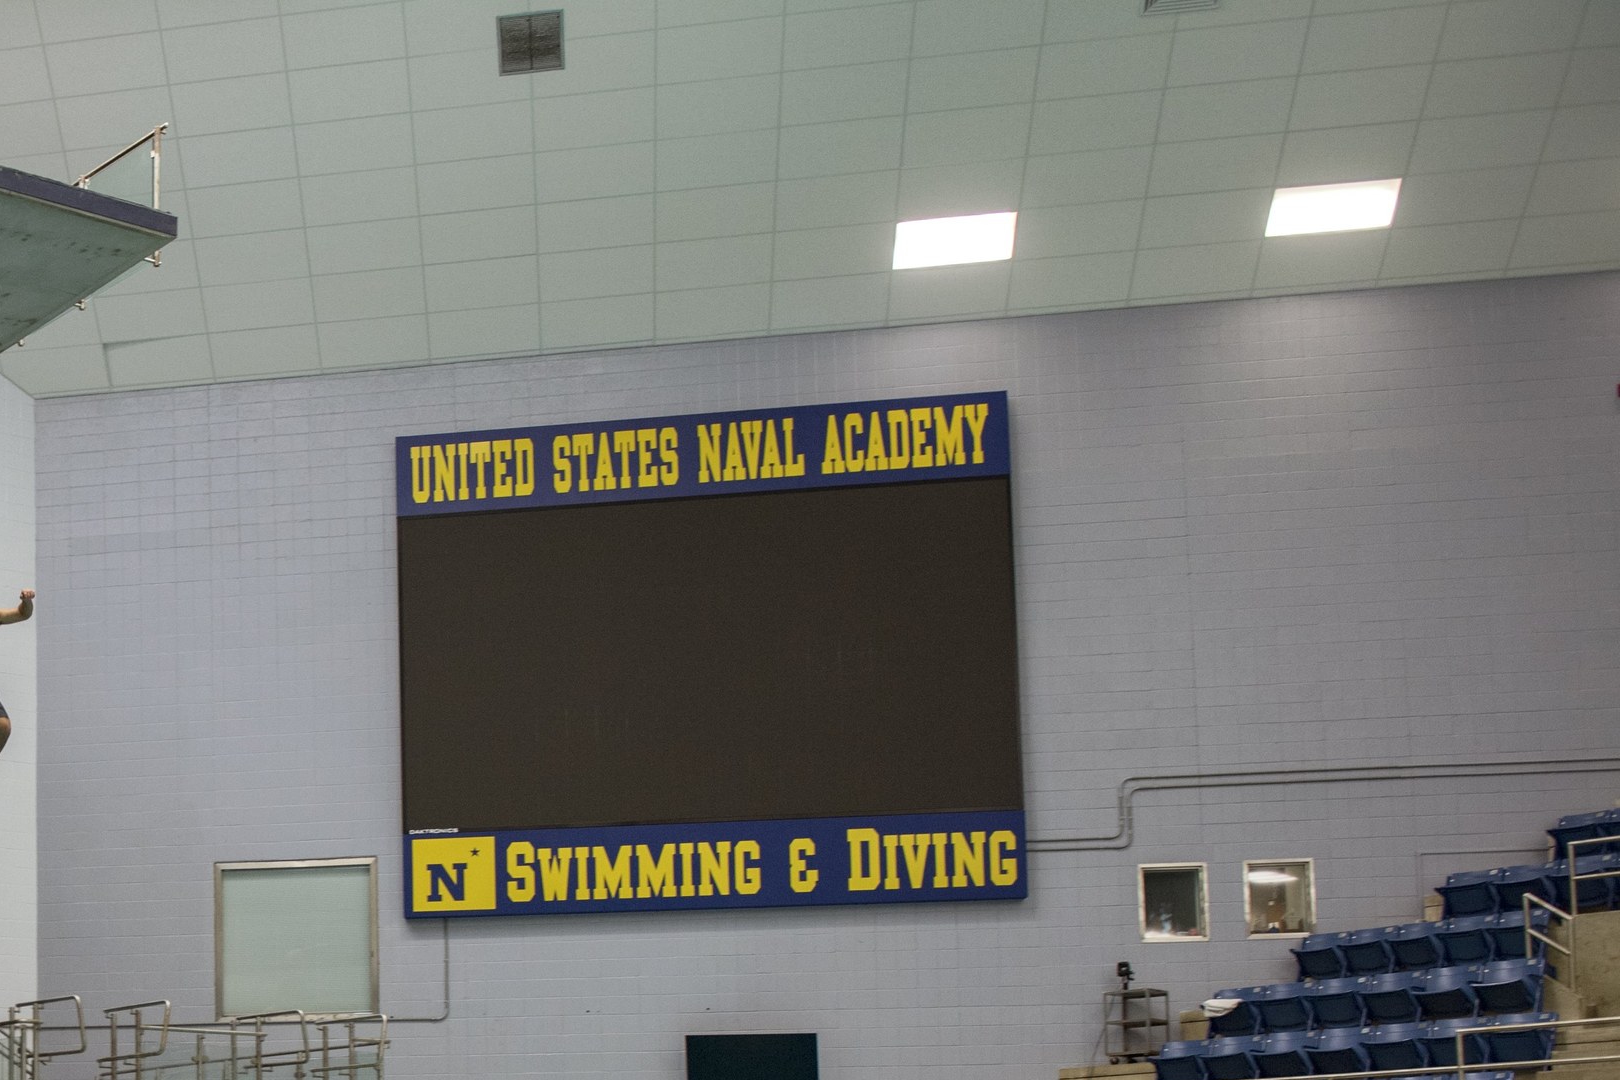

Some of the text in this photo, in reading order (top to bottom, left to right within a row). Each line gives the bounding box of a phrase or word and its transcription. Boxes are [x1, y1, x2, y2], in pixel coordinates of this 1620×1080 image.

[410, 403, 988, 504] UNITED STATES NAVAL ACADEMY
[426, 863, 467, 902] N
[506, 828, 1017, 902] SWIMMING & DIVING
